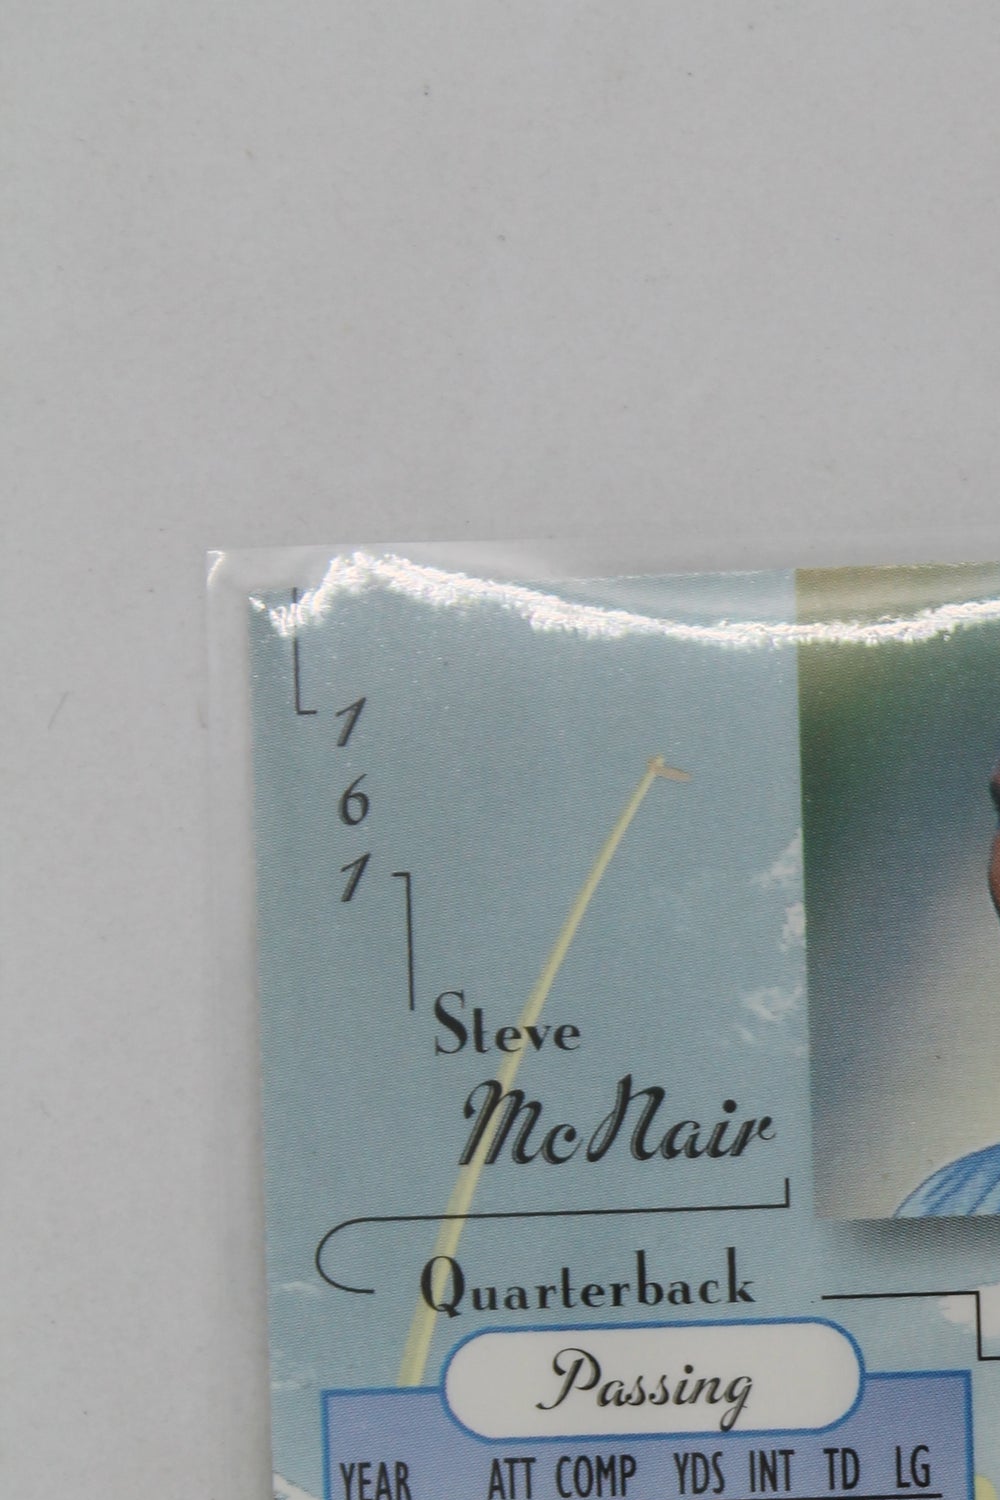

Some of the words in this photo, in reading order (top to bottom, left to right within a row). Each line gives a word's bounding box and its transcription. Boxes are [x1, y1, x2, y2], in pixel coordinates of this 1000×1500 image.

[434, 990, 581, 1056] Steve
[459, 1074, 776, 1165] McNair
[420, 1246, 756, 1318] Quarterback
[536, 1348, 753, 1432] Passing
[488, 1457, 536, 1499] ATT
[555, 1454, 637, 1498] COMP
[674, 1451, 726, 1494] YDS
[749, 1449, 795, 1491] INT
[824, 1448, 860, 1491] TD
[896, 1445, 931, 1488] LG
